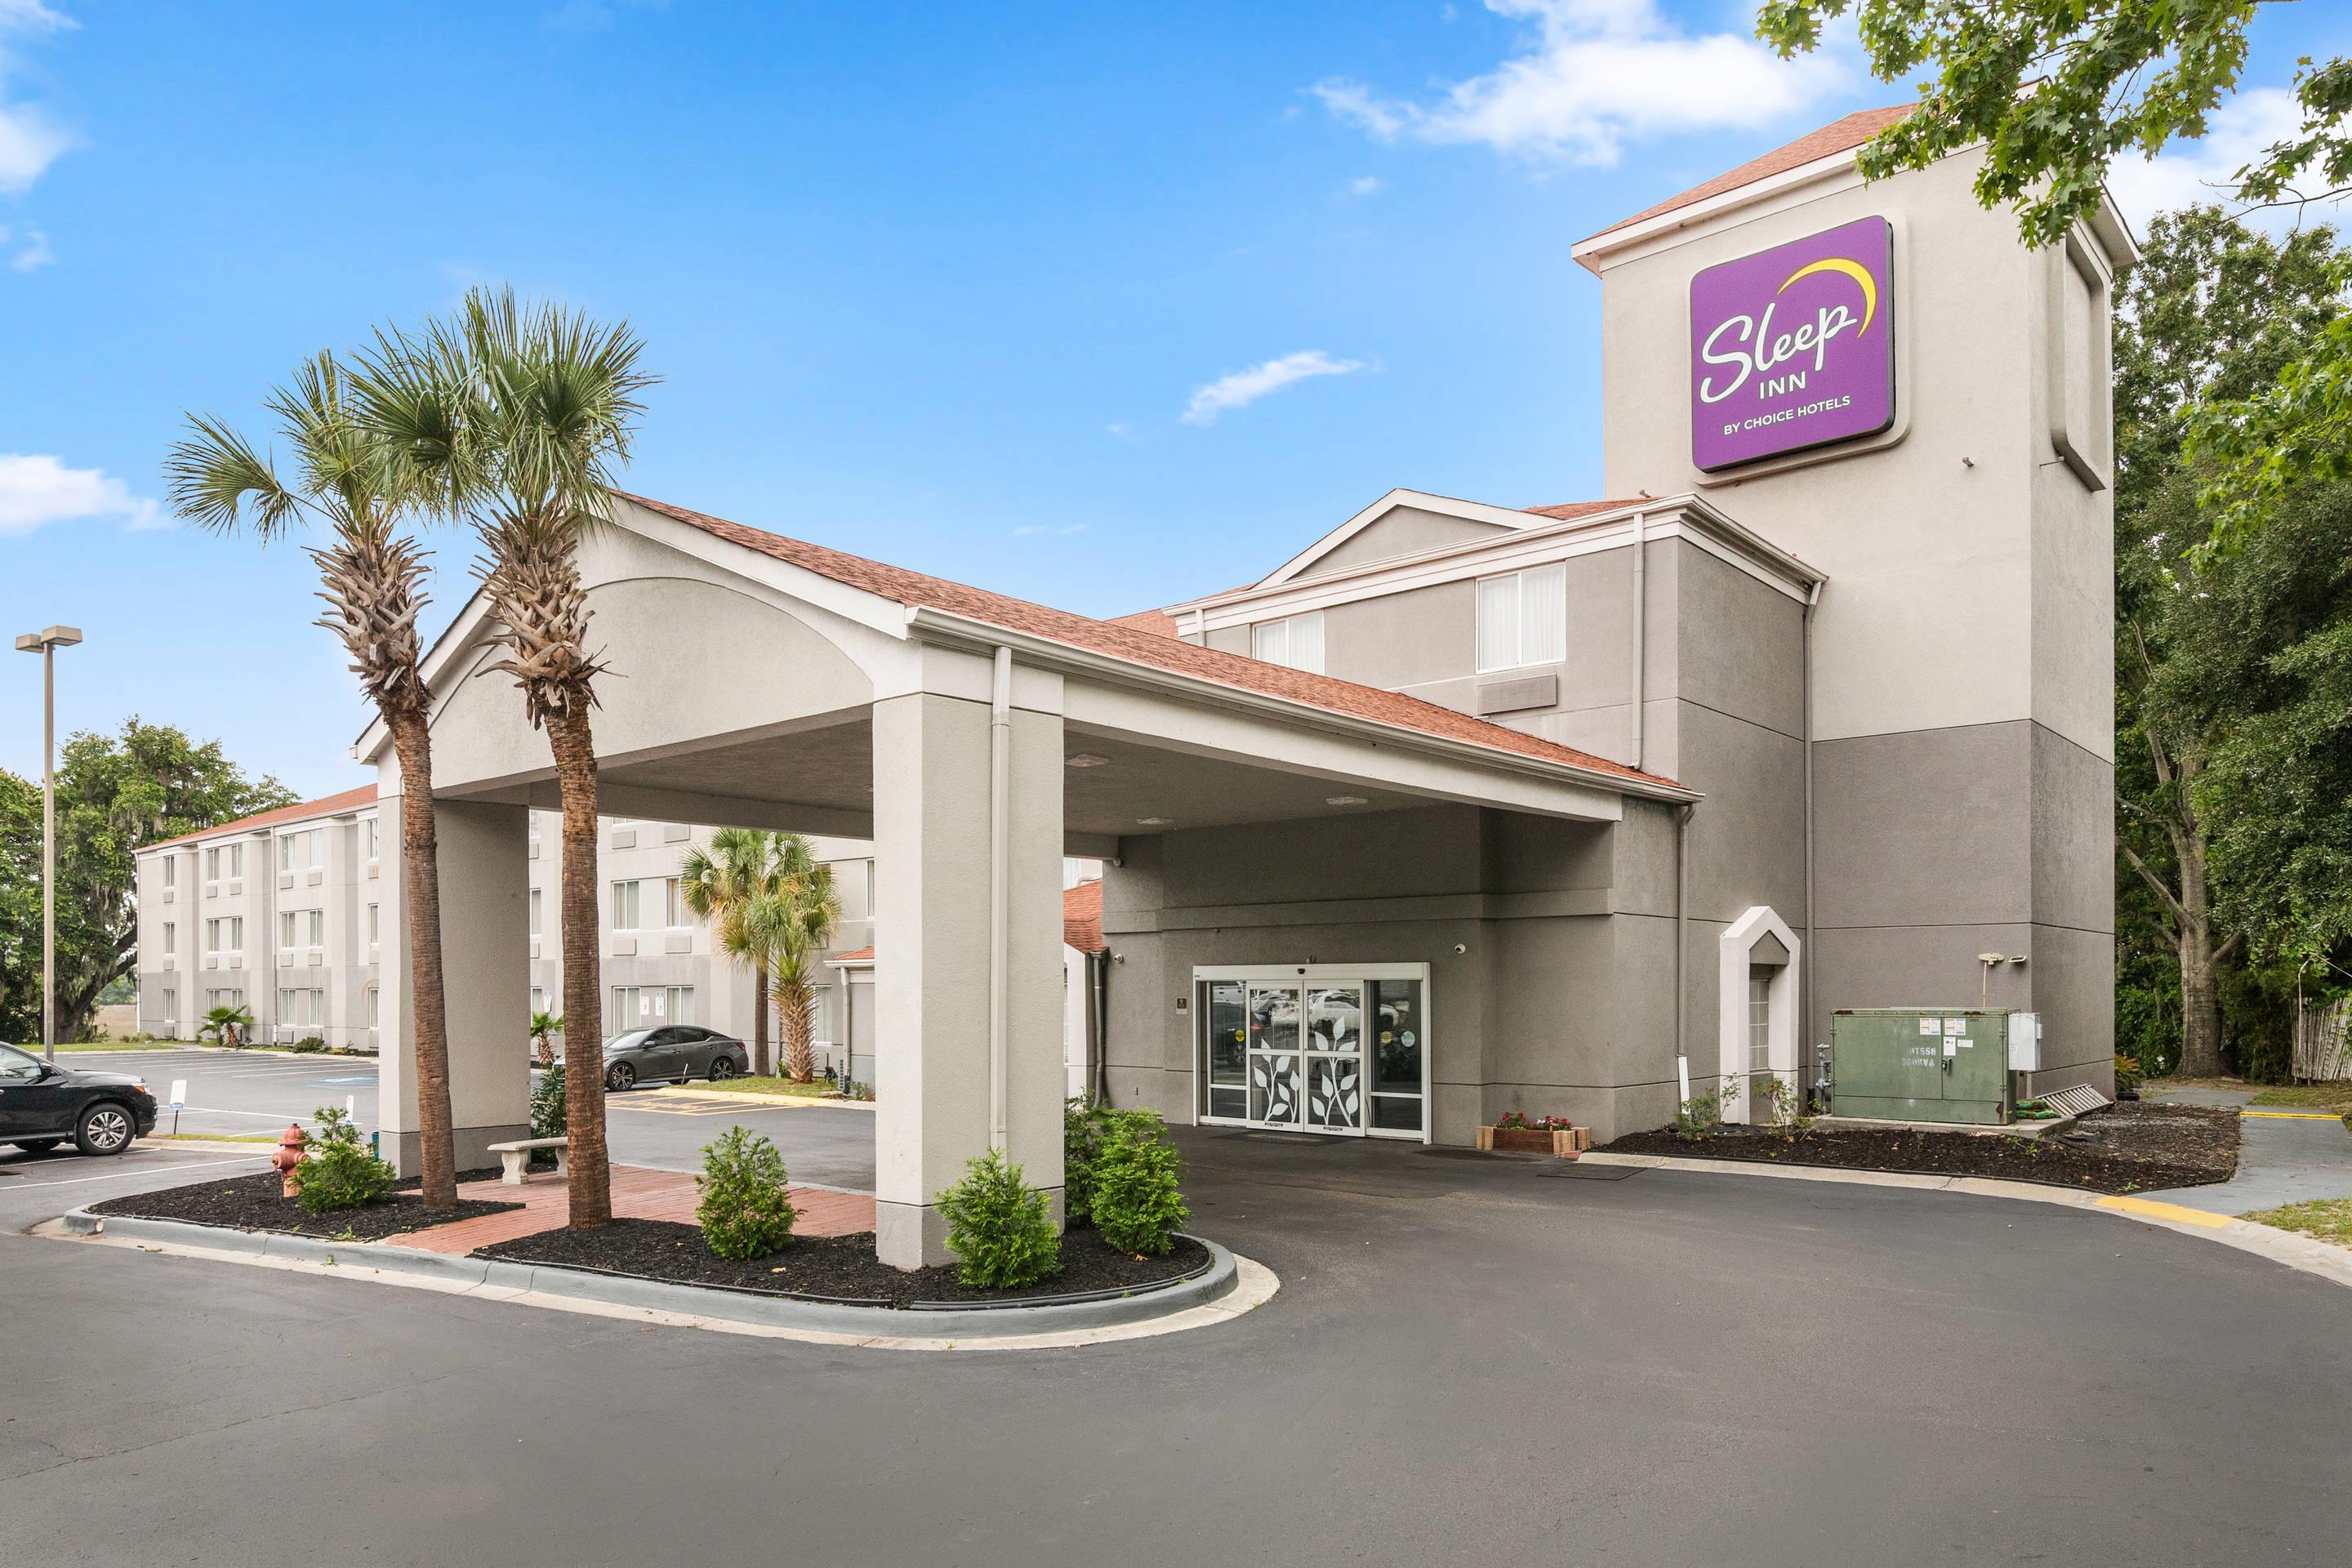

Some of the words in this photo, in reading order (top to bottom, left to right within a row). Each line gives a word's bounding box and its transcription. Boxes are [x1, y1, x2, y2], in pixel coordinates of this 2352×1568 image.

[1699, 302, 1857, 403] Sleep
[1759, 371, 1806, 399] INN
[1724, 422, 1740, 435] BY
[1744, 409, 1794, 430] CHOICE
[1797, 395, 1851, 417] HOTELS
